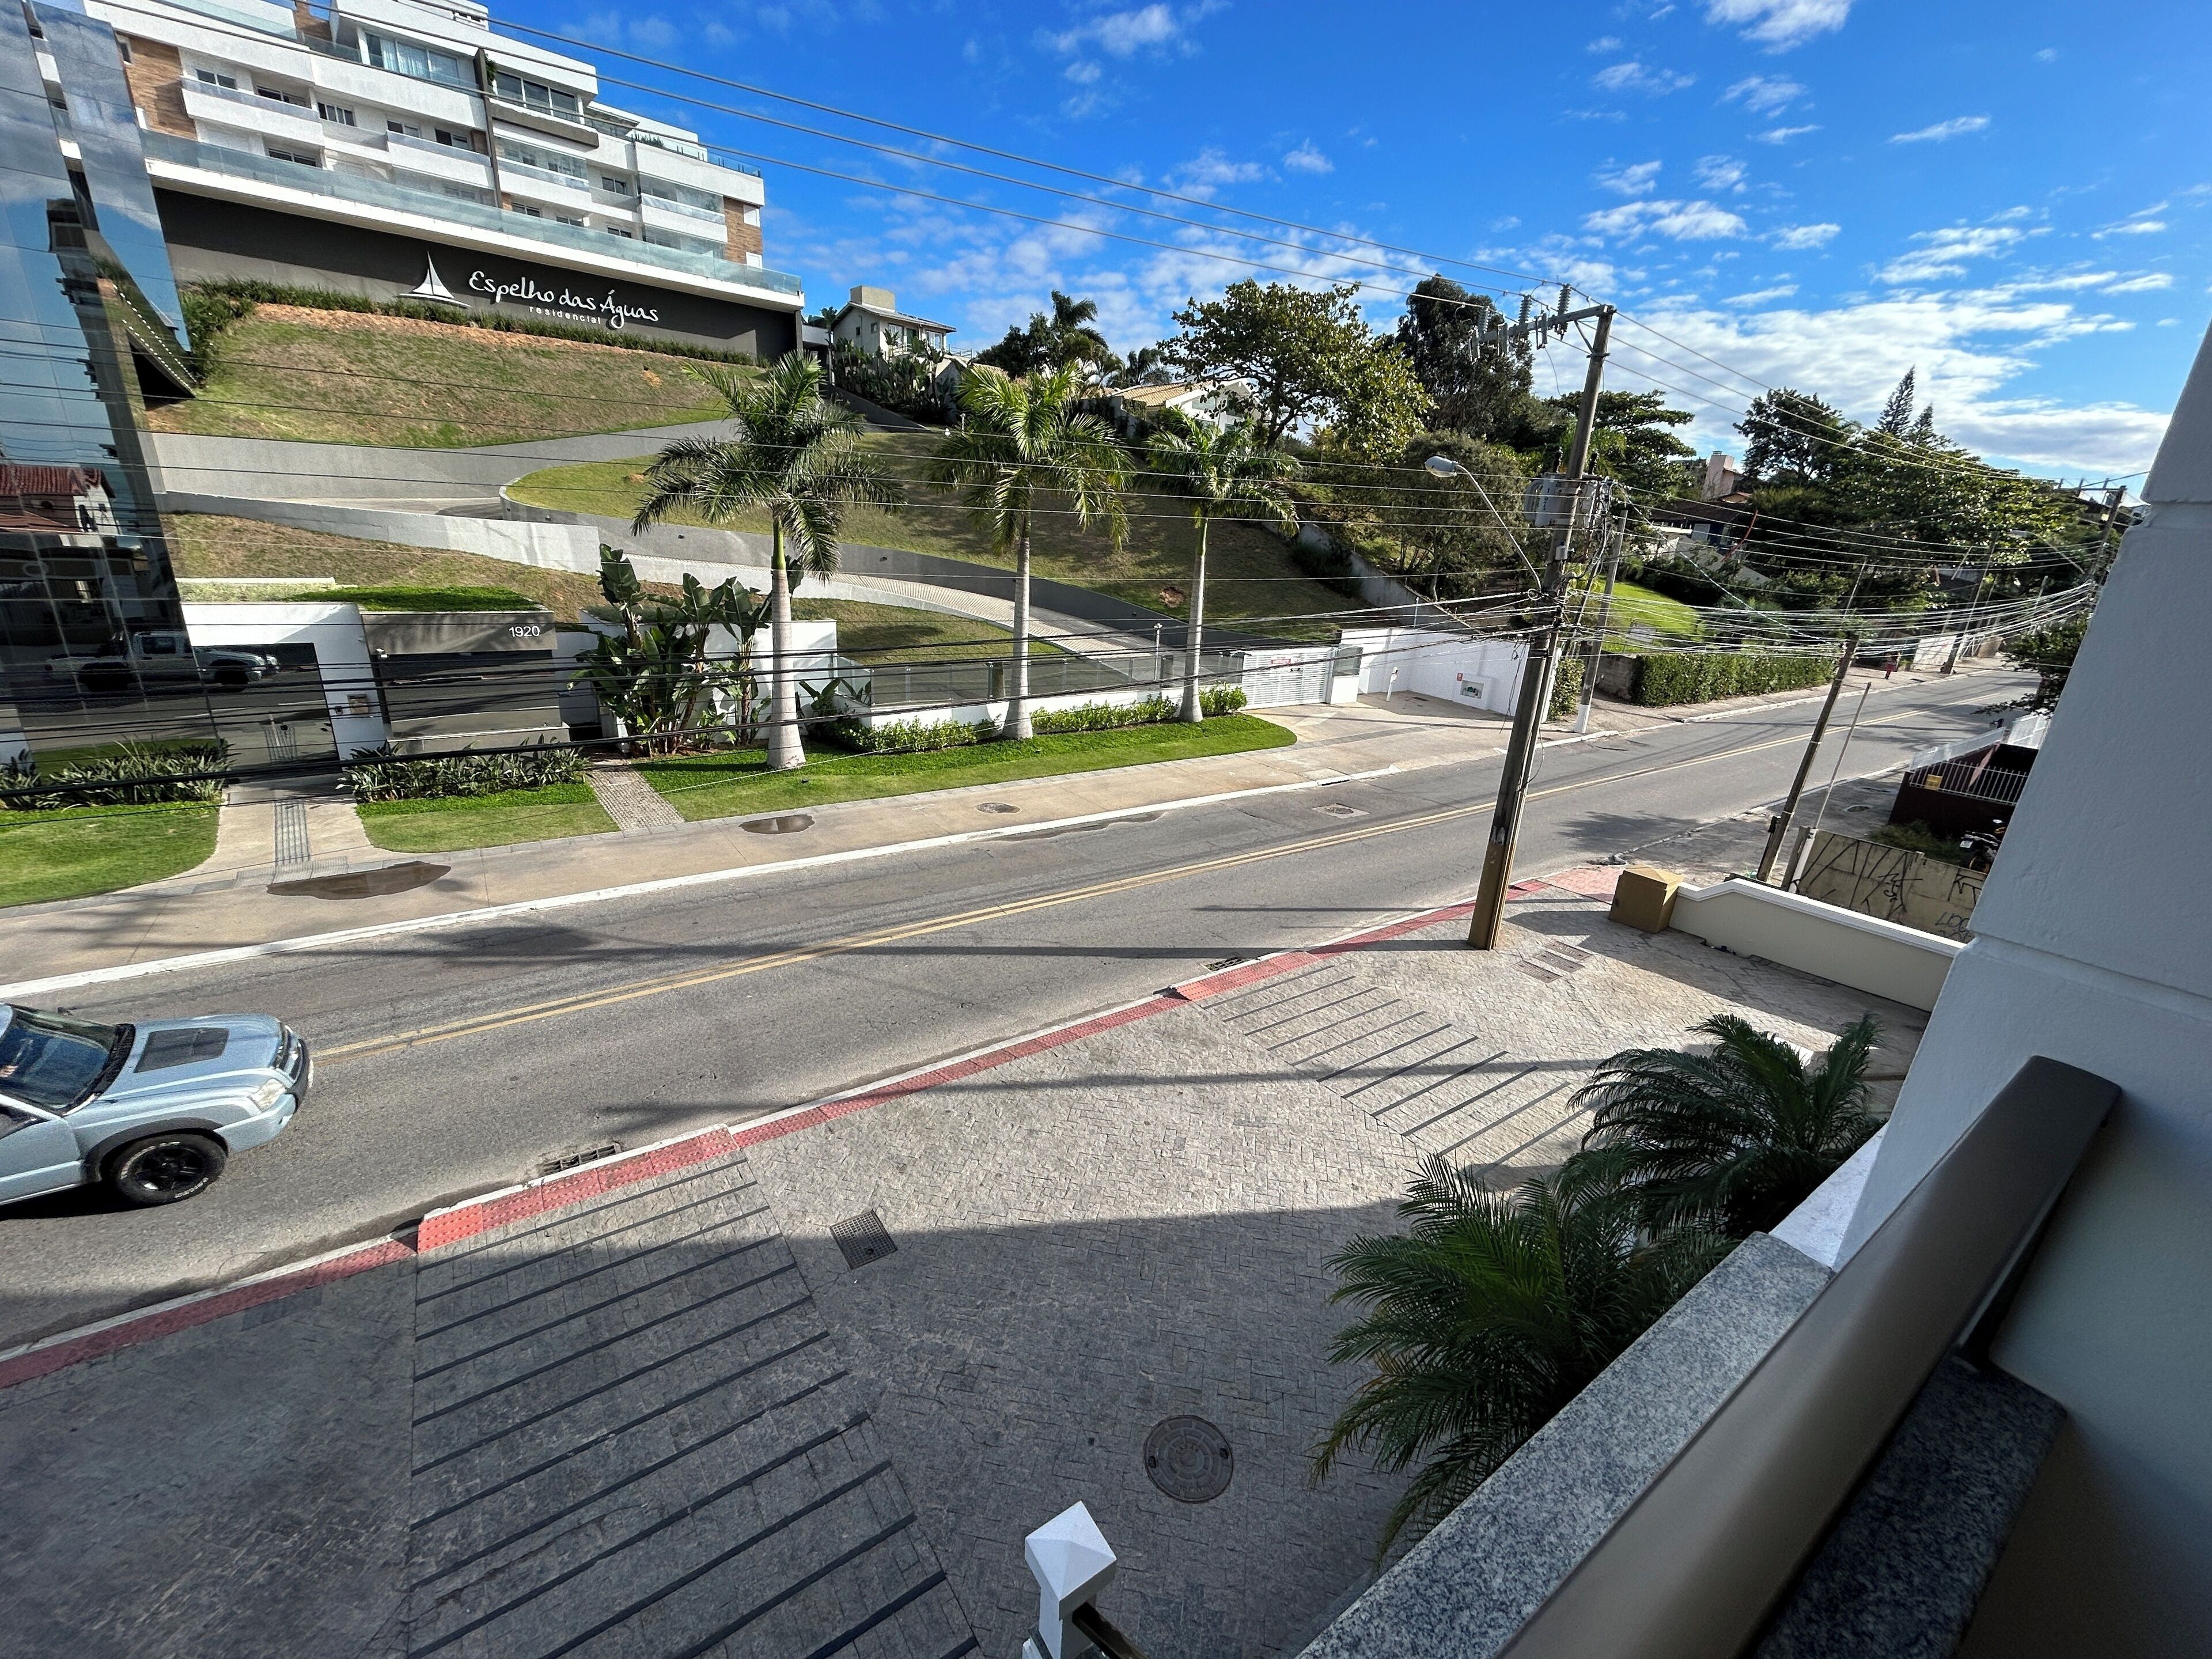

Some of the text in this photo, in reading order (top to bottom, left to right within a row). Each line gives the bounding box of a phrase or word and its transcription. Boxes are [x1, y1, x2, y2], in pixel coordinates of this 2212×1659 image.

[469, 271, 659, 329] Espelho das Águas
[529, 306, 601, 324] residencial
[509, 626, 540, 637] 1920
